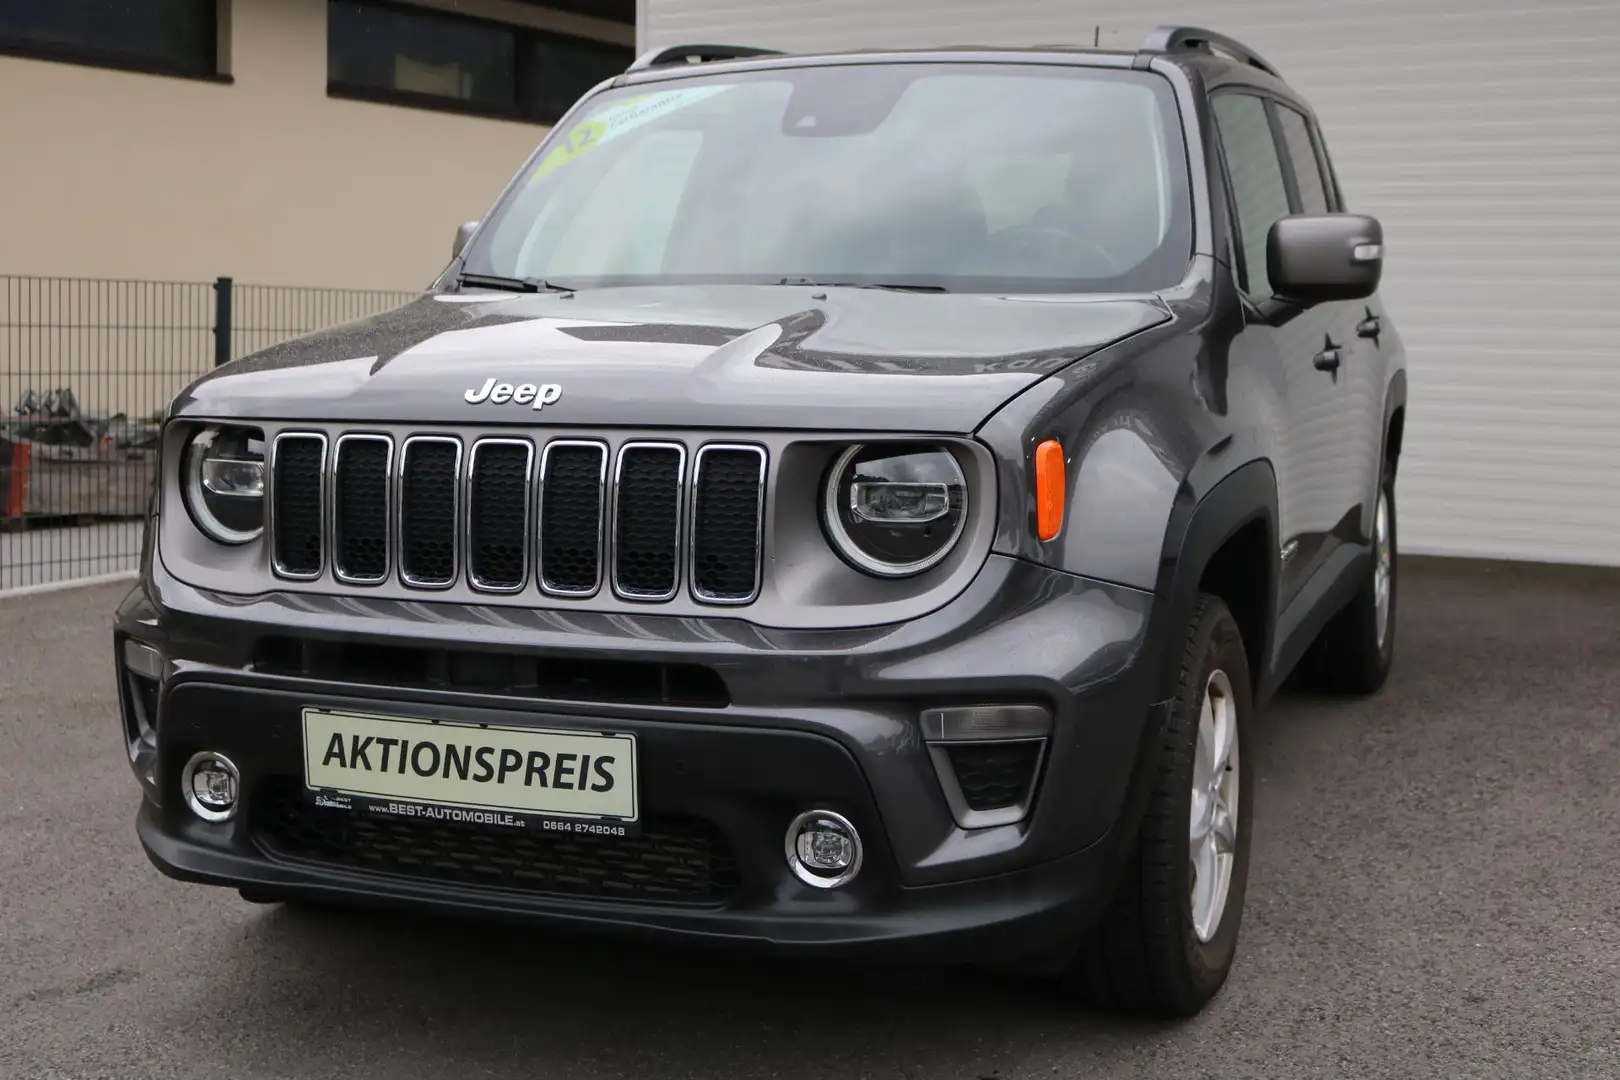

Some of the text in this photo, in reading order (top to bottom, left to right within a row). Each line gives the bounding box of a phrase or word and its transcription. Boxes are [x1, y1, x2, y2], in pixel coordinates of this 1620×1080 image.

[464, 378, 563, 411] Jeep
[322, 732, 617, 793] AKTIONSPREIS
[368, 803, 625, 837] www.BEST-AUTOMOBILE.at 0664 2742048
